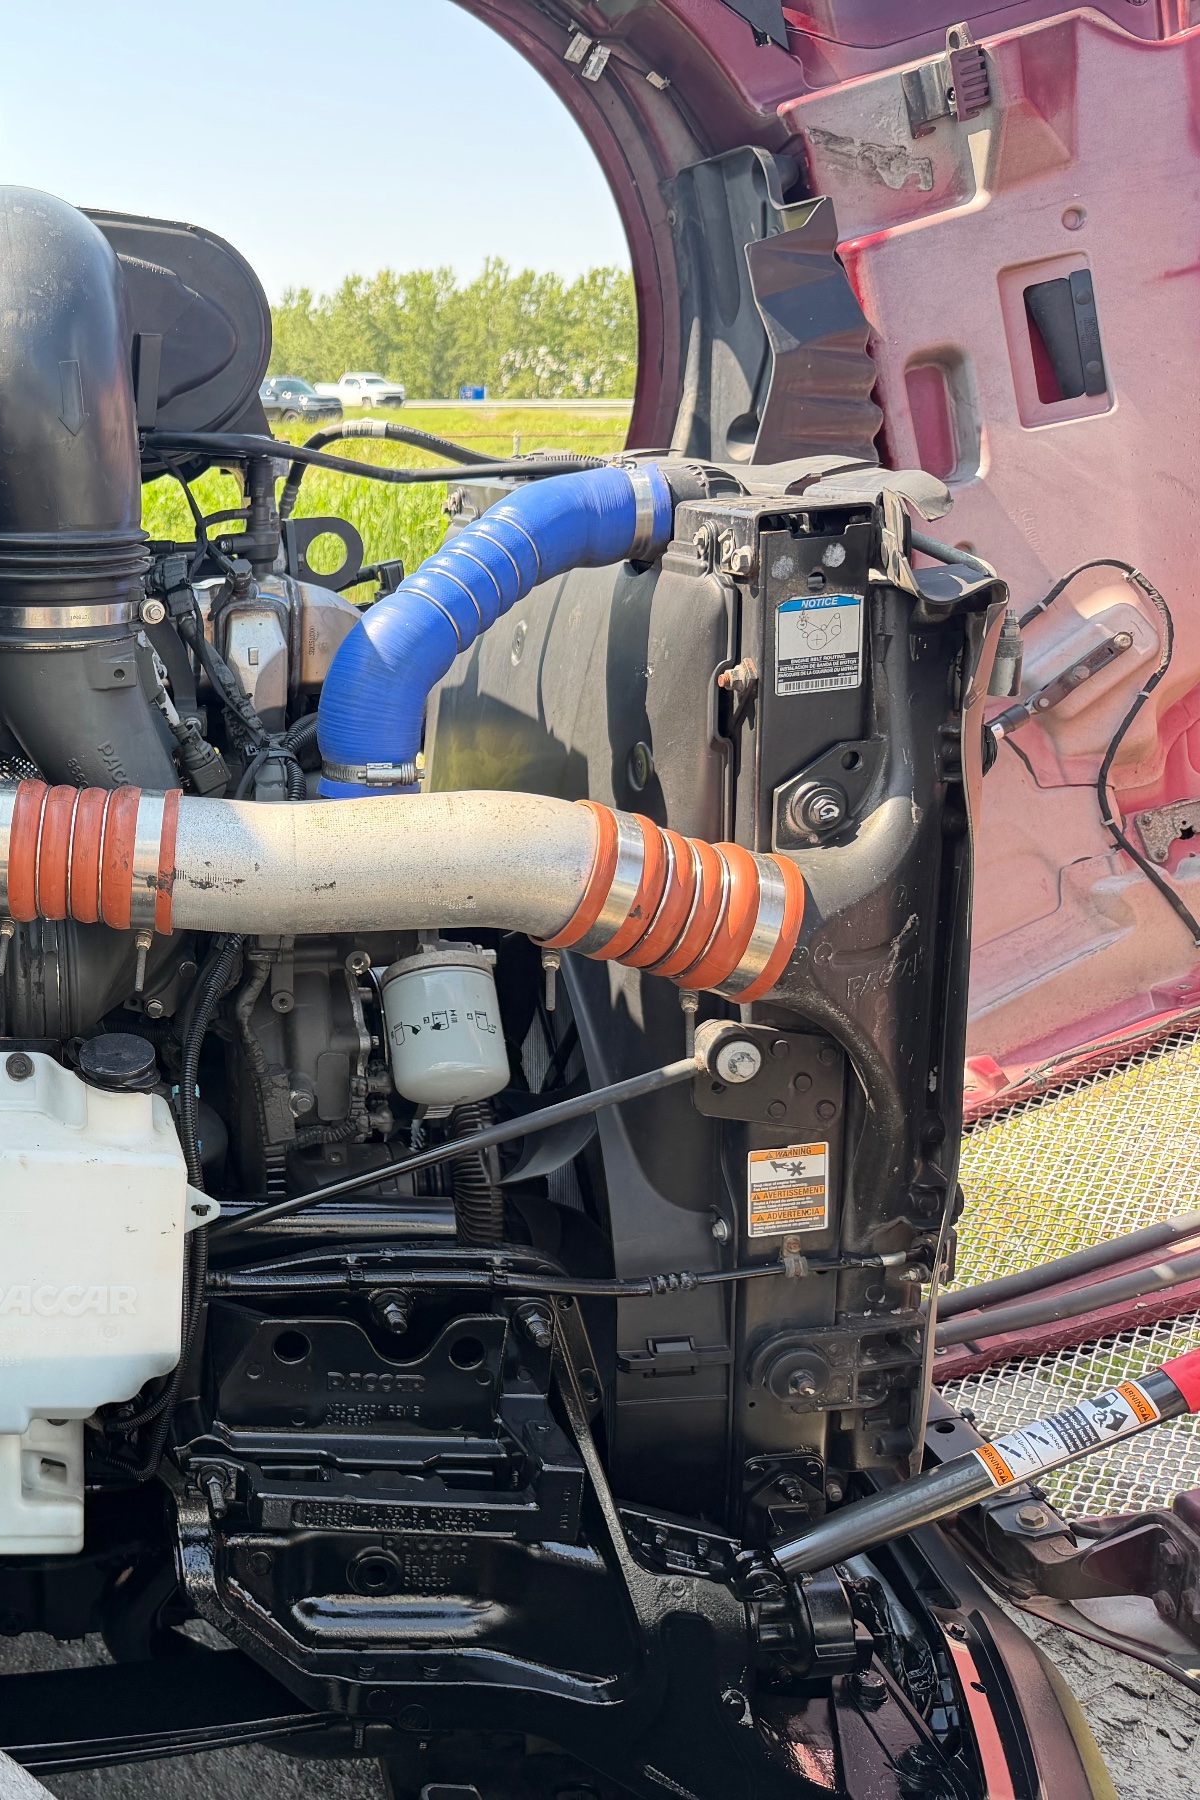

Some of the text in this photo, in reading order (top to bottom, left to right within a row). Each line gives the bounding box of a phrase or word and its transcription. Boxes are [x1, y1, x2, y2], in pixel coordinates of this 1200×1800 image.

[802, 597, 839, 608] NOTICE
[775, 1146, 812, 1158] WARNING
[762, 1185, 824, 1199] AVERTISSEMENT
[766, 1207, 820, 1220] ADVERTENCIA
[327, 1371, 426, 1393] PACCAR
